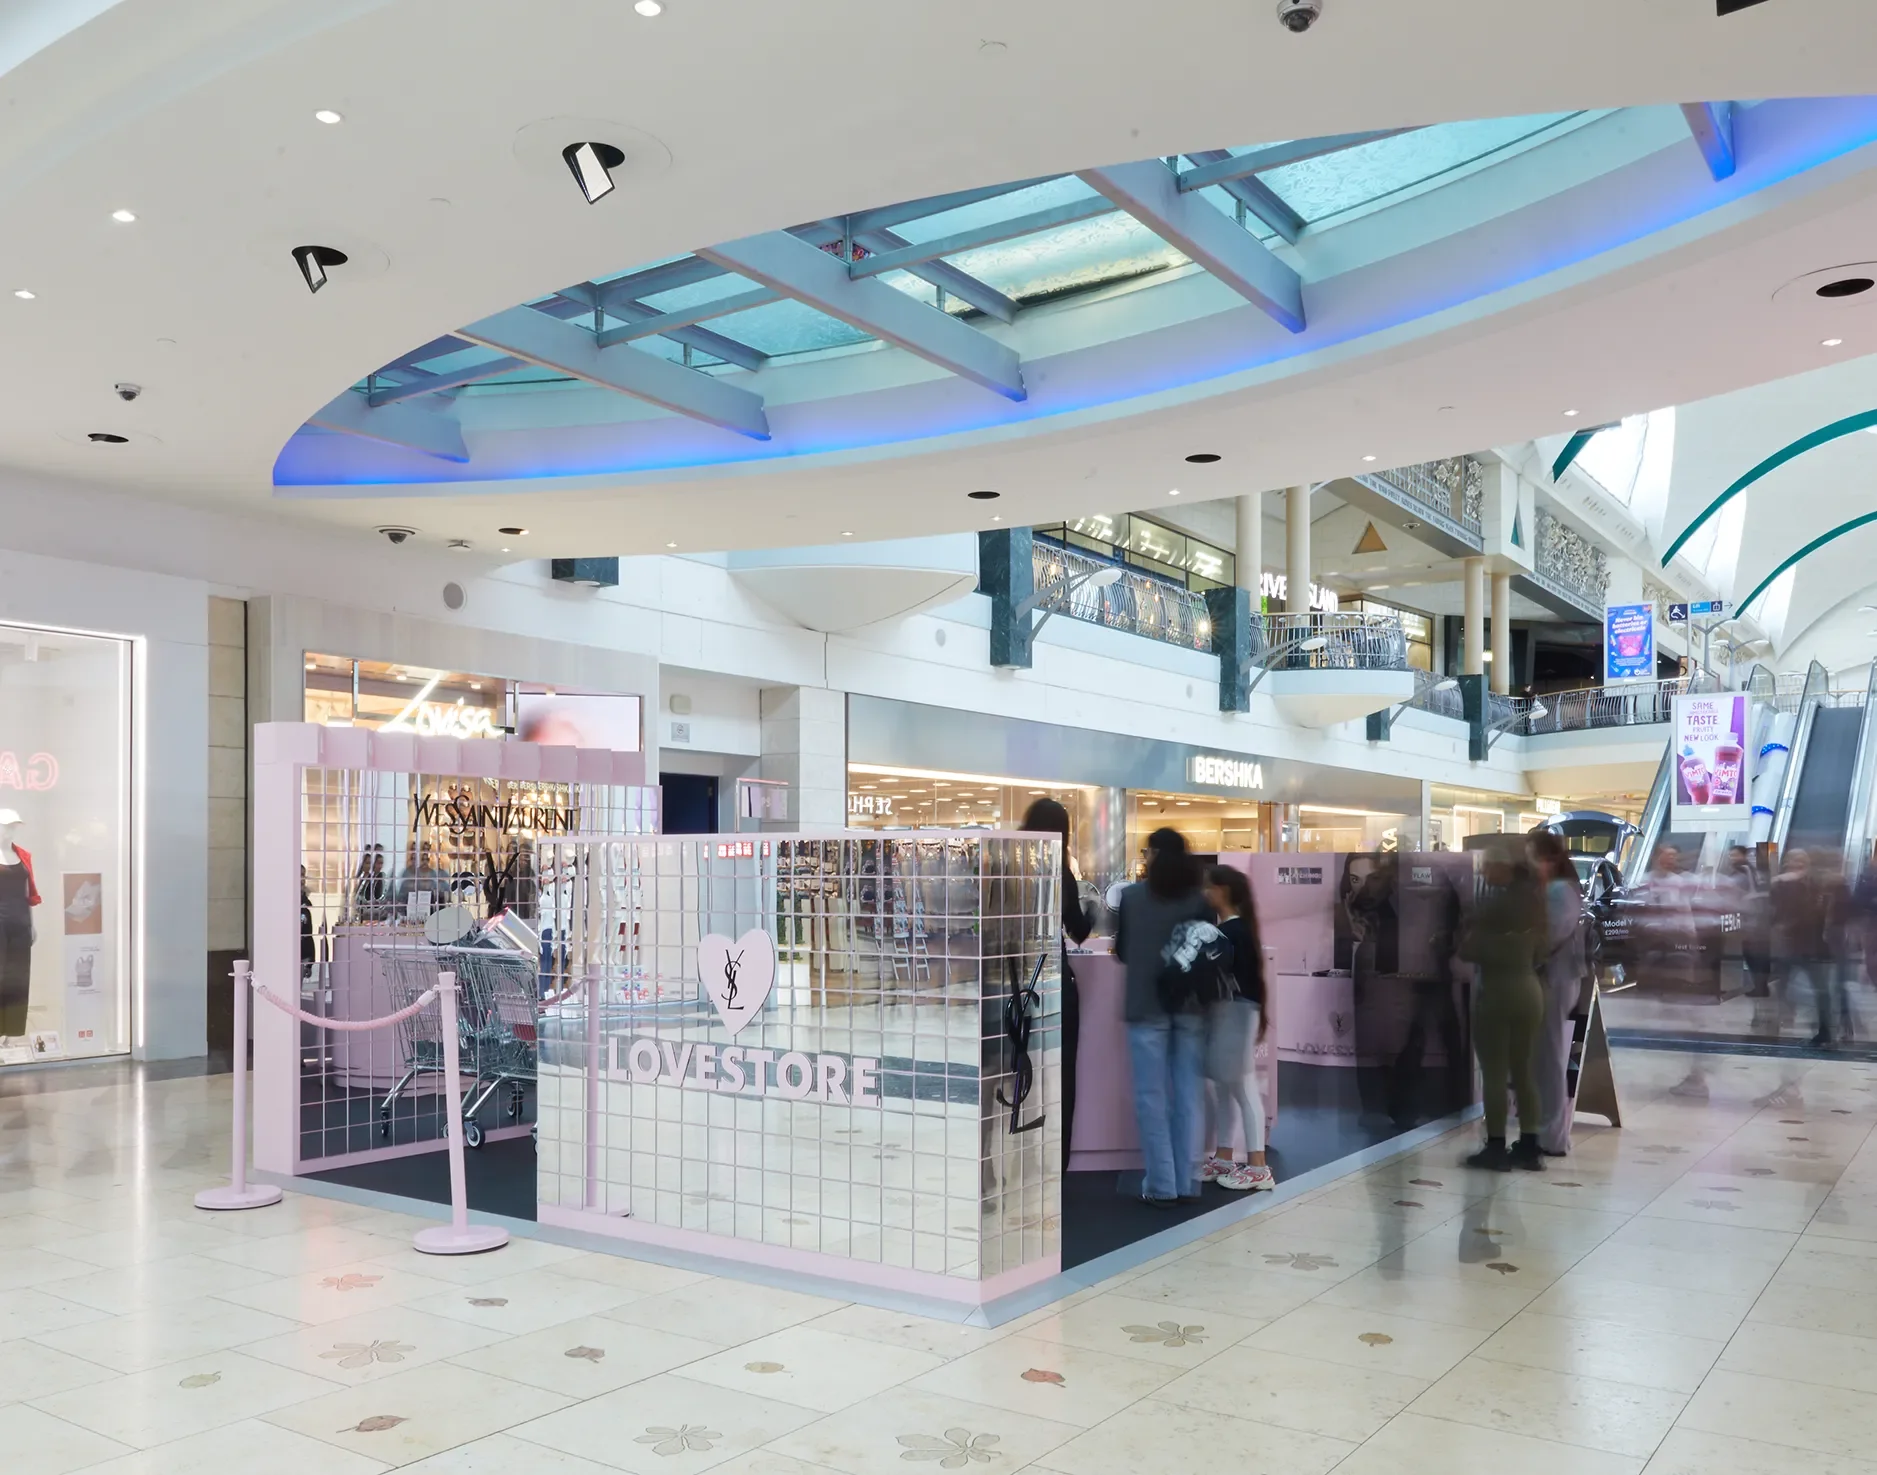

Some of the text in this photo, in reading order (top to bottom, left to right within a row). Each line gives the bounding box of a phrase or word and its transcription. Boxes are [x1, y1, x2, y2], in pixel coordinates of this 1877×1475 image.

[377, 671, 505, 738] Lovisa
[1692, 702, 1714, 710] SAME
[1686, 715, 1718, 725] TASTE
[1684, 733, 1720, 742] NEW LOOK
[1194, 756, 1263, 789] BERSHKA
[1604, 919, 1627, 927] Model
[1720, 913, 1741, 932] TESLA
[720, 948, 745, 1010] YSL
[608, 1037, 881, 1107] LOVESTORE
